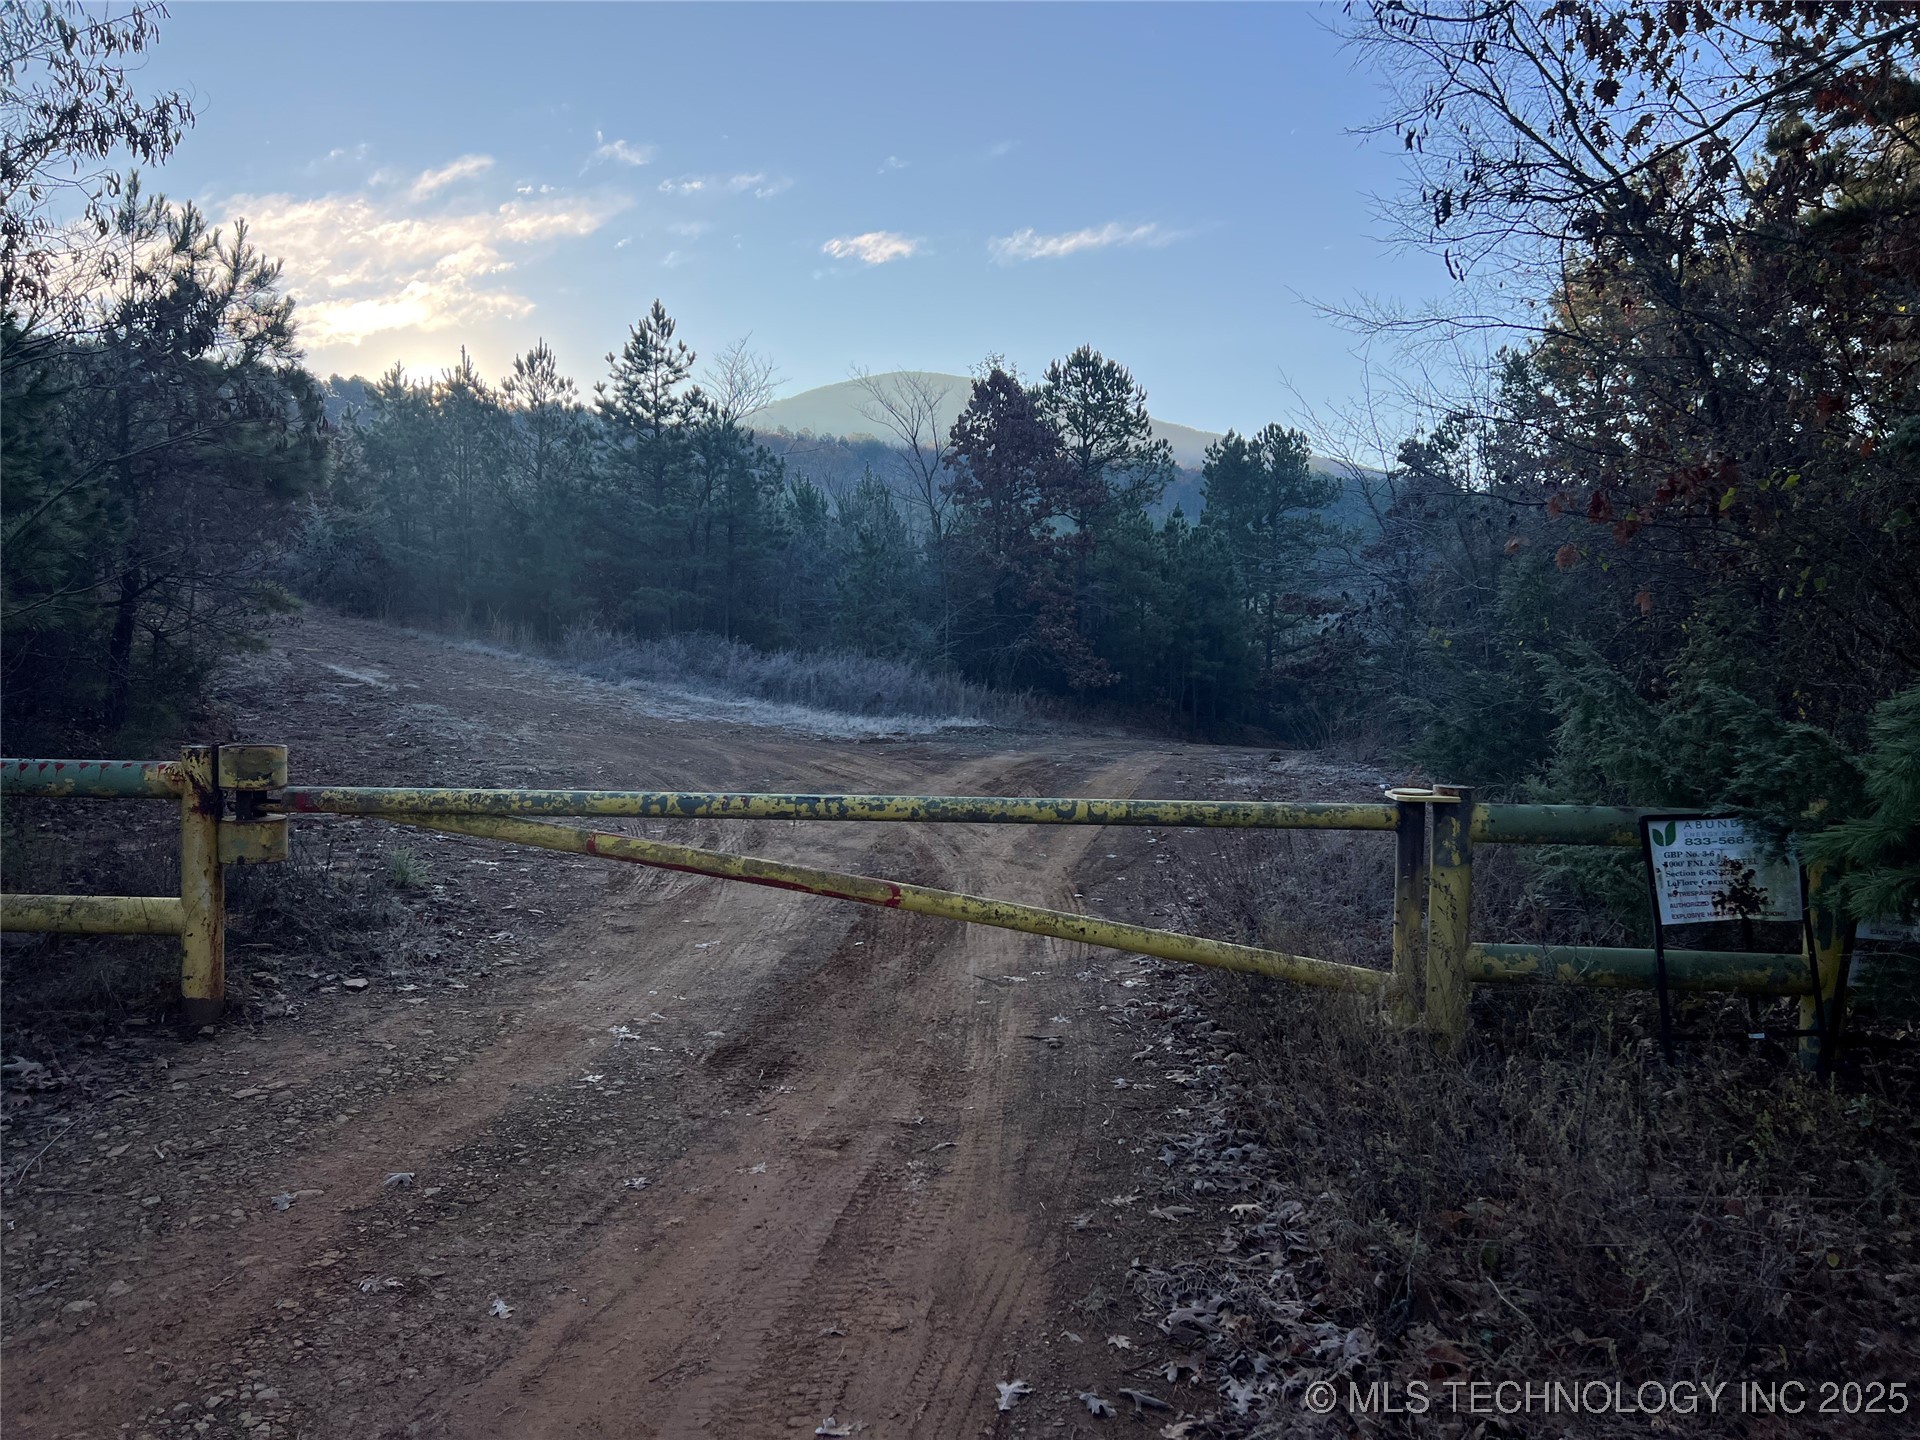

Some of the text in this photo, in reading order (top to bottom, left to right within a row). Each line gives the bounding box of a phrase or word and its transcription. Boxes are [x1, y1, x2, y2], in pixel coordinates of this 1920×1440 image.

[1684, 820, 1741, 830] ABUND
[1663, 851, 1683, 859] GBP
[1685, 850, 1700, 858] No.
[1663, 860, 1685, 868] 000'
[1708, 859, 1715, 867] &
[1701, 879, 1733, 887] Cunty
